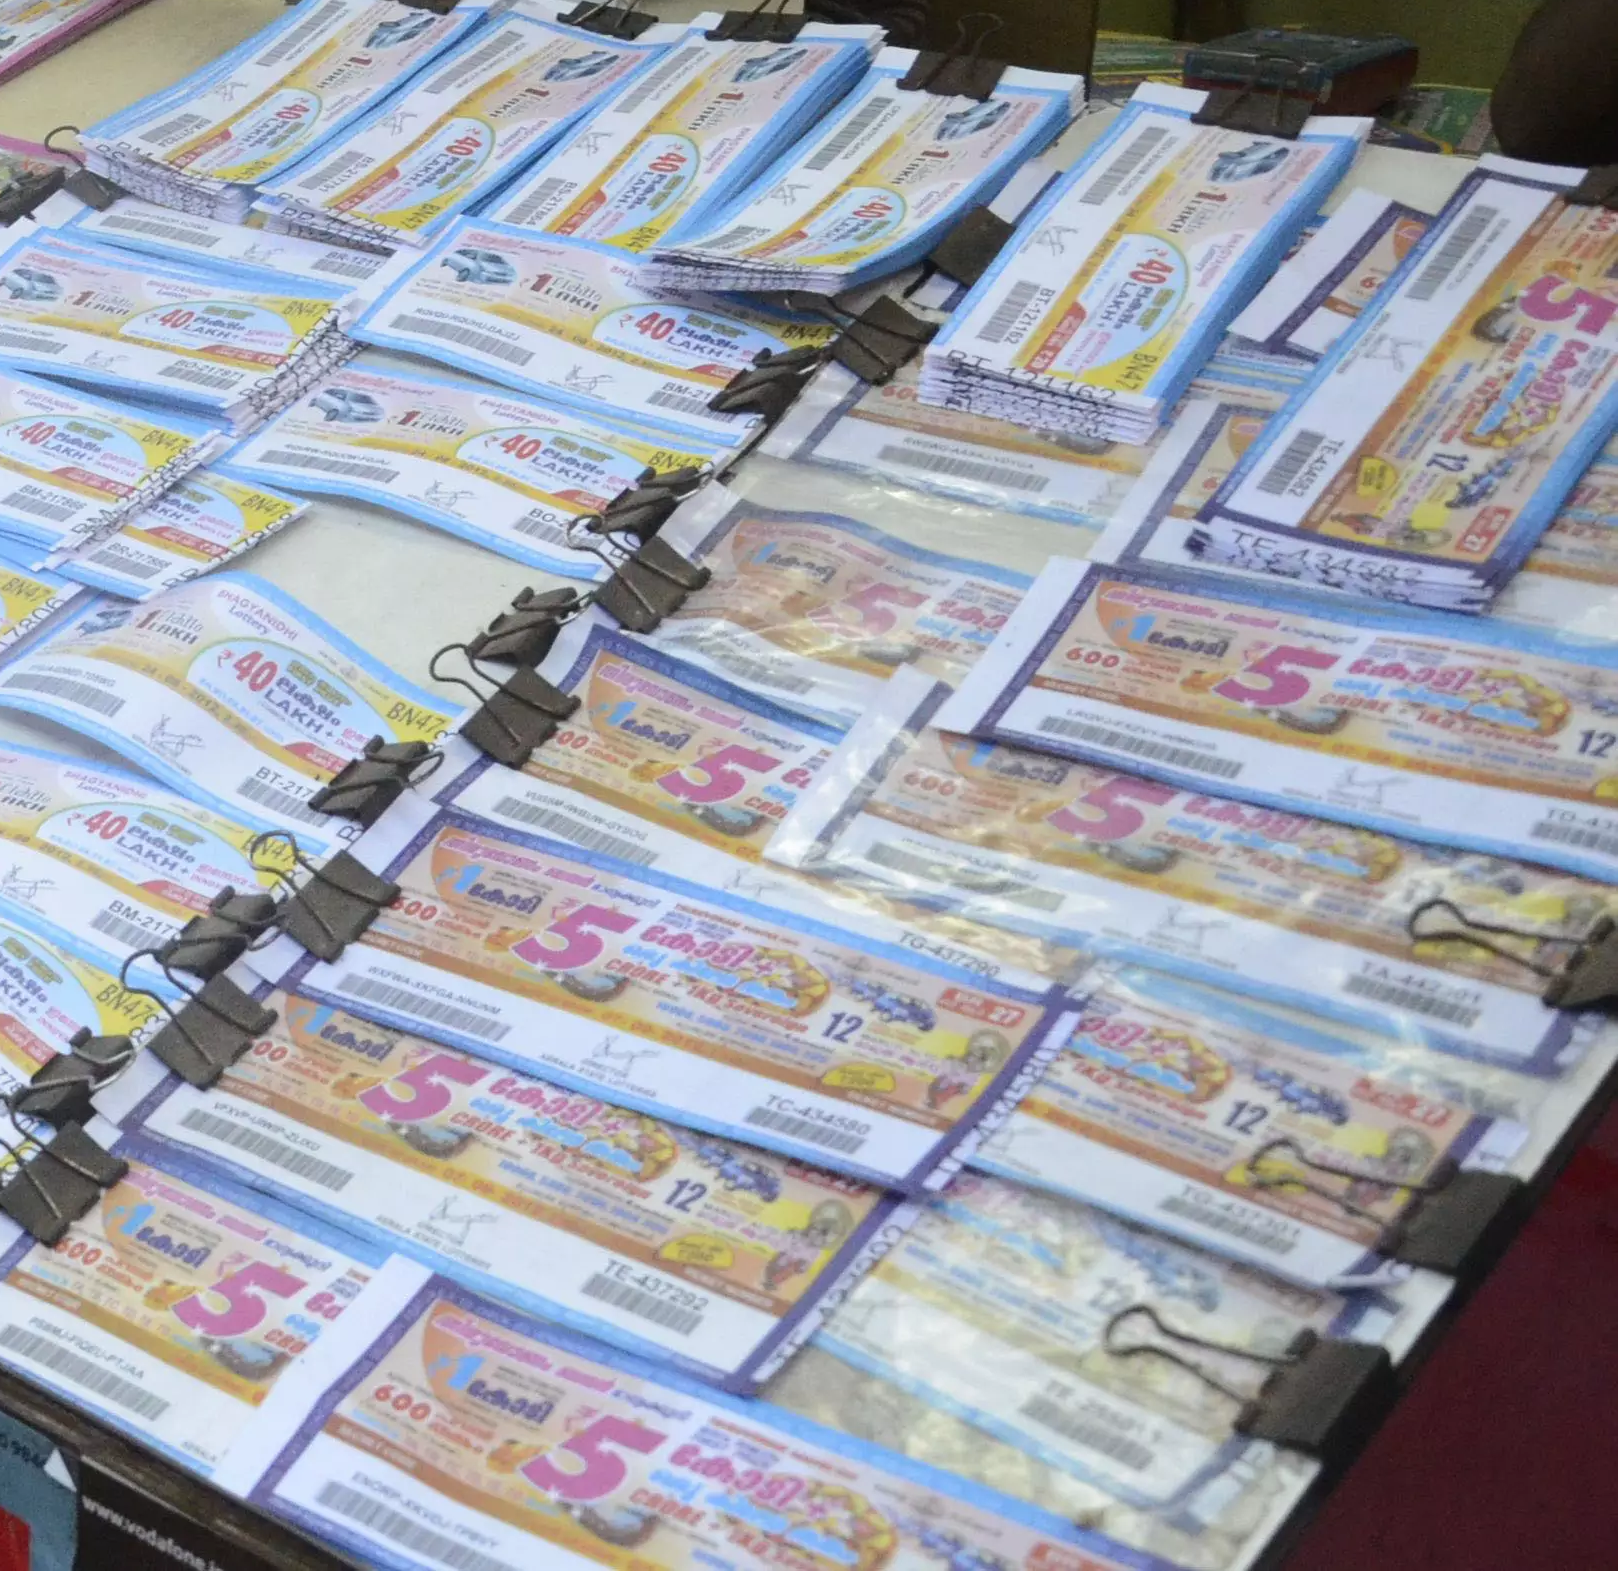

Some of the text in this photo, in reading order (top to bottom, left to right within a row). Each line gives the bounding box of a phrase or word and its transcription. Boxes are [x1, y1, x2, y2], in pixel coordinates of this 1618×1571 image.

[1104, 282, 1138, 322] LAKH
[1520, 275, 1617, 337] 5
[182, 325, 229, 342] LAKH
[666, 334, 727, 360] LAKH
[41, 439, 86, 461] LAKH
[528, 456, 588, 482] LAKH
[217, 589, 299, 641] BHAGYANIDHI
[227, 606, 270, 635] Lottery
[1064, 644, 1121, 670] 600
[1213, 643, 1341, 708] 5
[264, 688, 324, 735] LAKH
[1576, 729, 1617, 758] 12
[255, 766, 314, 799] BT-217
[655, 743, 784, 805] 5
[1047, 776, 1178, 842] 5
[114, 833, 180, 875] LAKH
[510, 904, 640, 973] 5
[821, 1010, 865, 1043] 12
[357, 1052, 492, 1122] 5
[1224, 1099, 1269, 1136] 12
[664, 1178, 708, 1212] 12
[172, 1262, 310, 1338] 5
[604, 1258, 710, 1311] TE-437292
[371, 1384, 433, 1423] 600
[518, 1412, 669, 1501] 5
